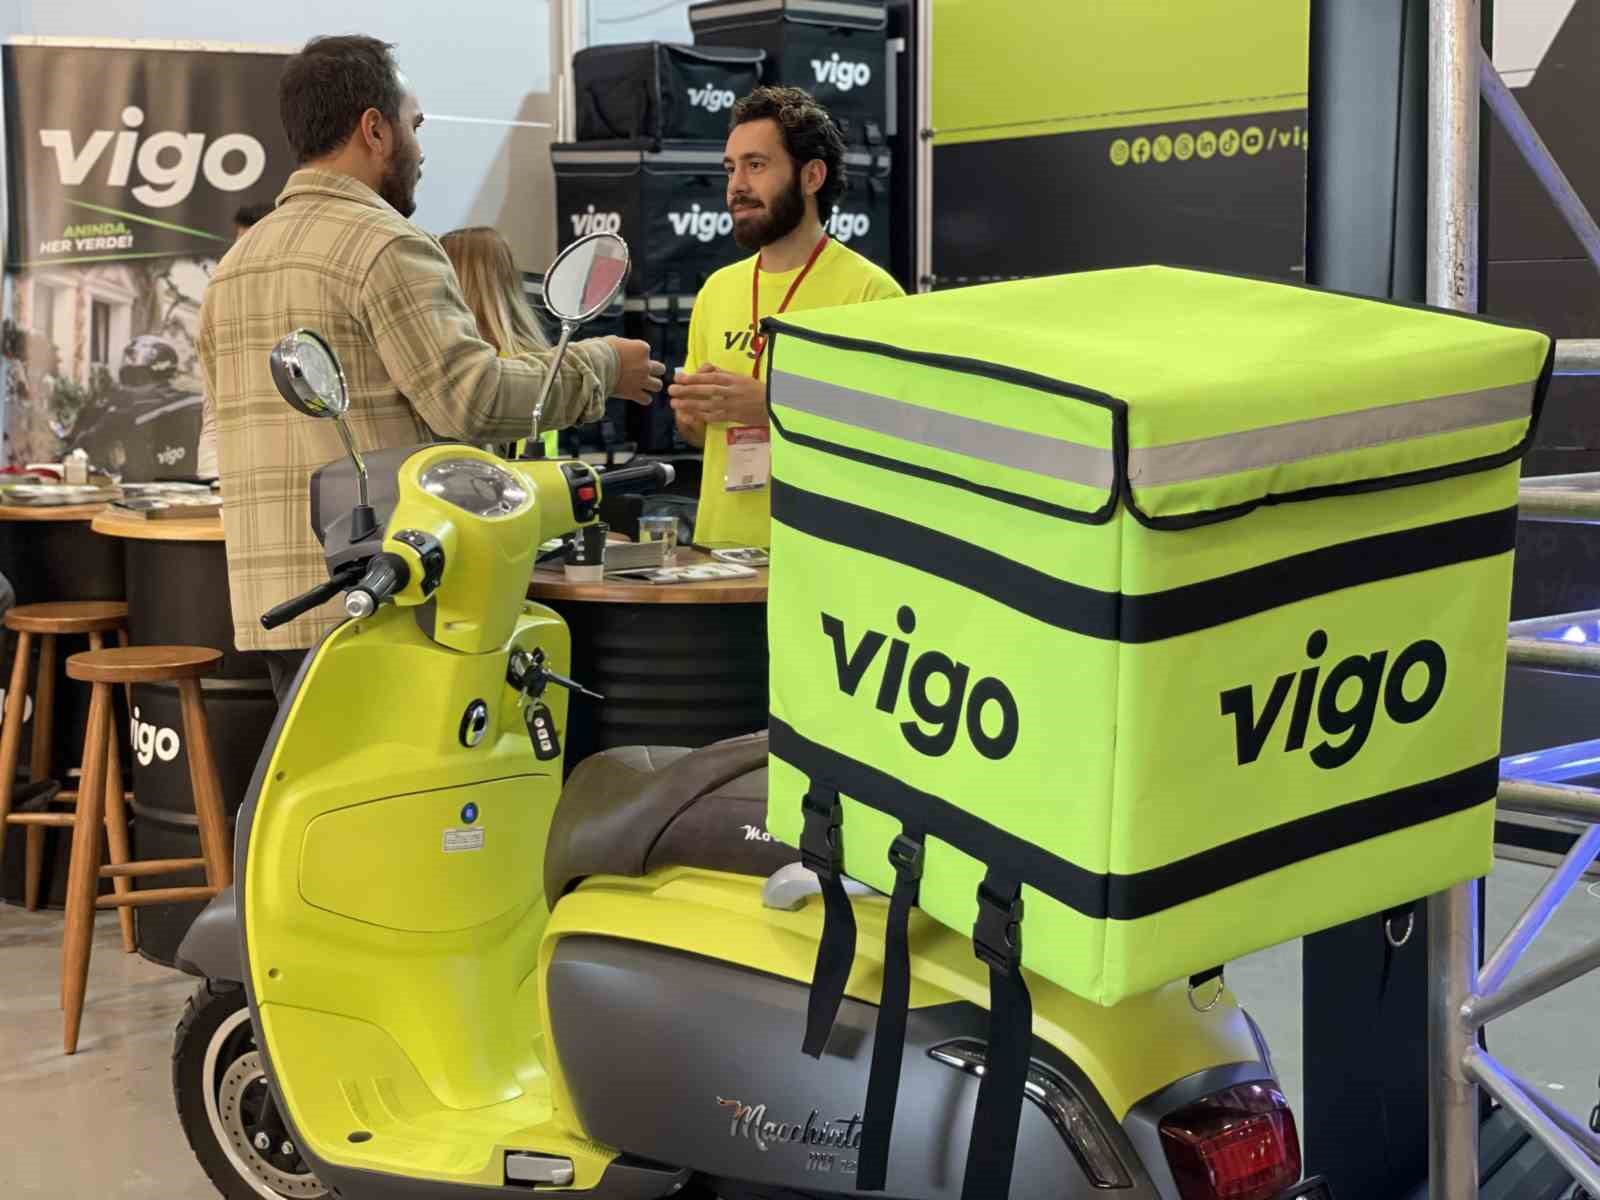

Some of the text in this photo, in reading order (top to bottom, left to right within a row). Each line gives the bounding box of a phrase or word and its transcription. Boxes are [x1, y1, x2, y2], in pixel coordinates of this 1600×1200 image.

[810, 52, 871, 91] vigo
[687, 82, 736, 112] vigo
[39, 105, 266, 208] vigo
[667, 203, 734, 242] vigo
[823, 204, 870, 242] igo
[39, 234, 134, 254] HER YERDE!
[157, 445, 186, 466] vigo
[820, 604, 1020, 761] vigo
[1219, 629, 1448, 770] vigo
[130, 705, 180, 767] igo
